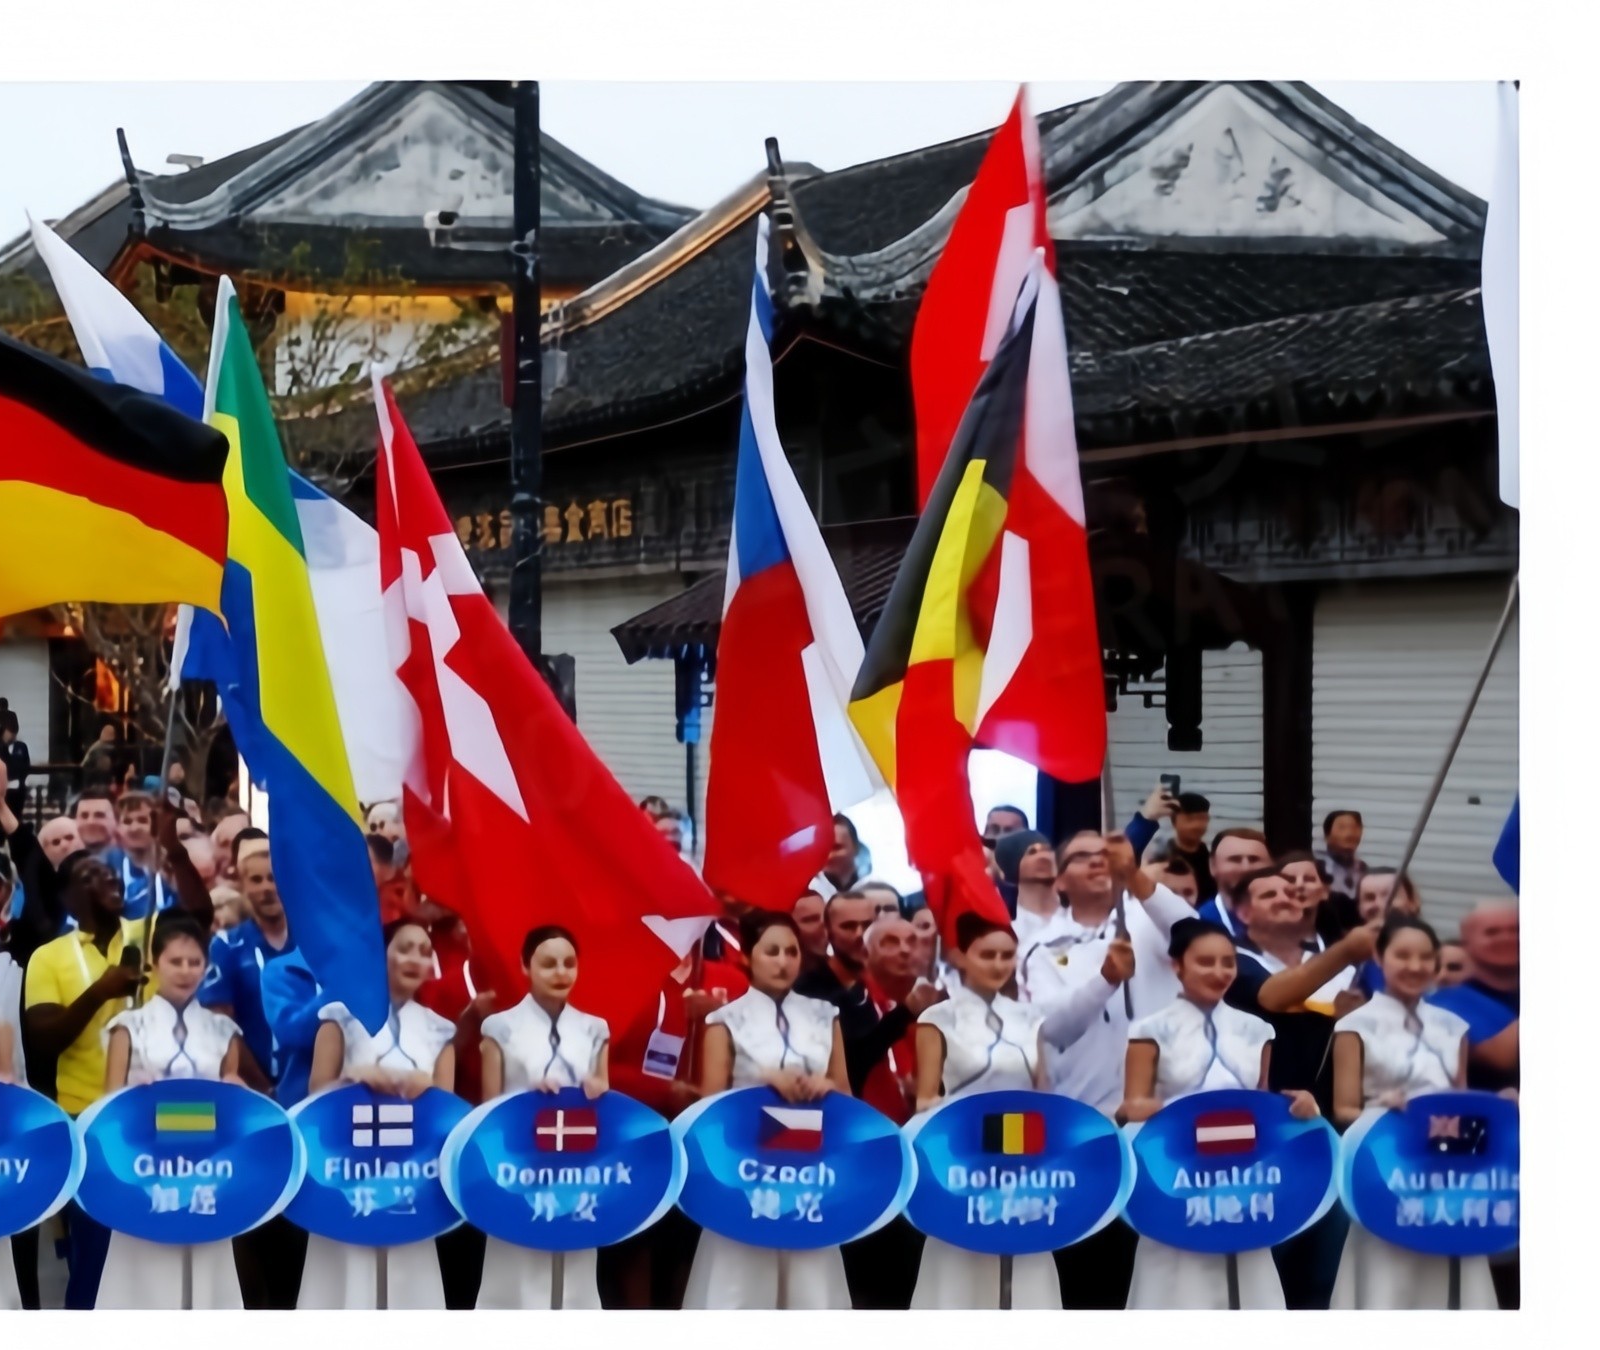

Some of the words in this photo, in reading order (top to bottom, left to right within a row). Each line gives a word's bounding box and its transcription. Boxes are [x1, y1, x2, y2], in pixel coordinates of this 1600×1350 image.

[133, 1152, 233, 1178] Gabon
[324, 1156, 441, 1181] Finland
[498, 1160, 633, 1186] Denmark
[737, 1158, 836, 1187] Czech
[947, 1164, 1076, 1193] Belgium
[1172, 1162, 1282, 1190] Austria
